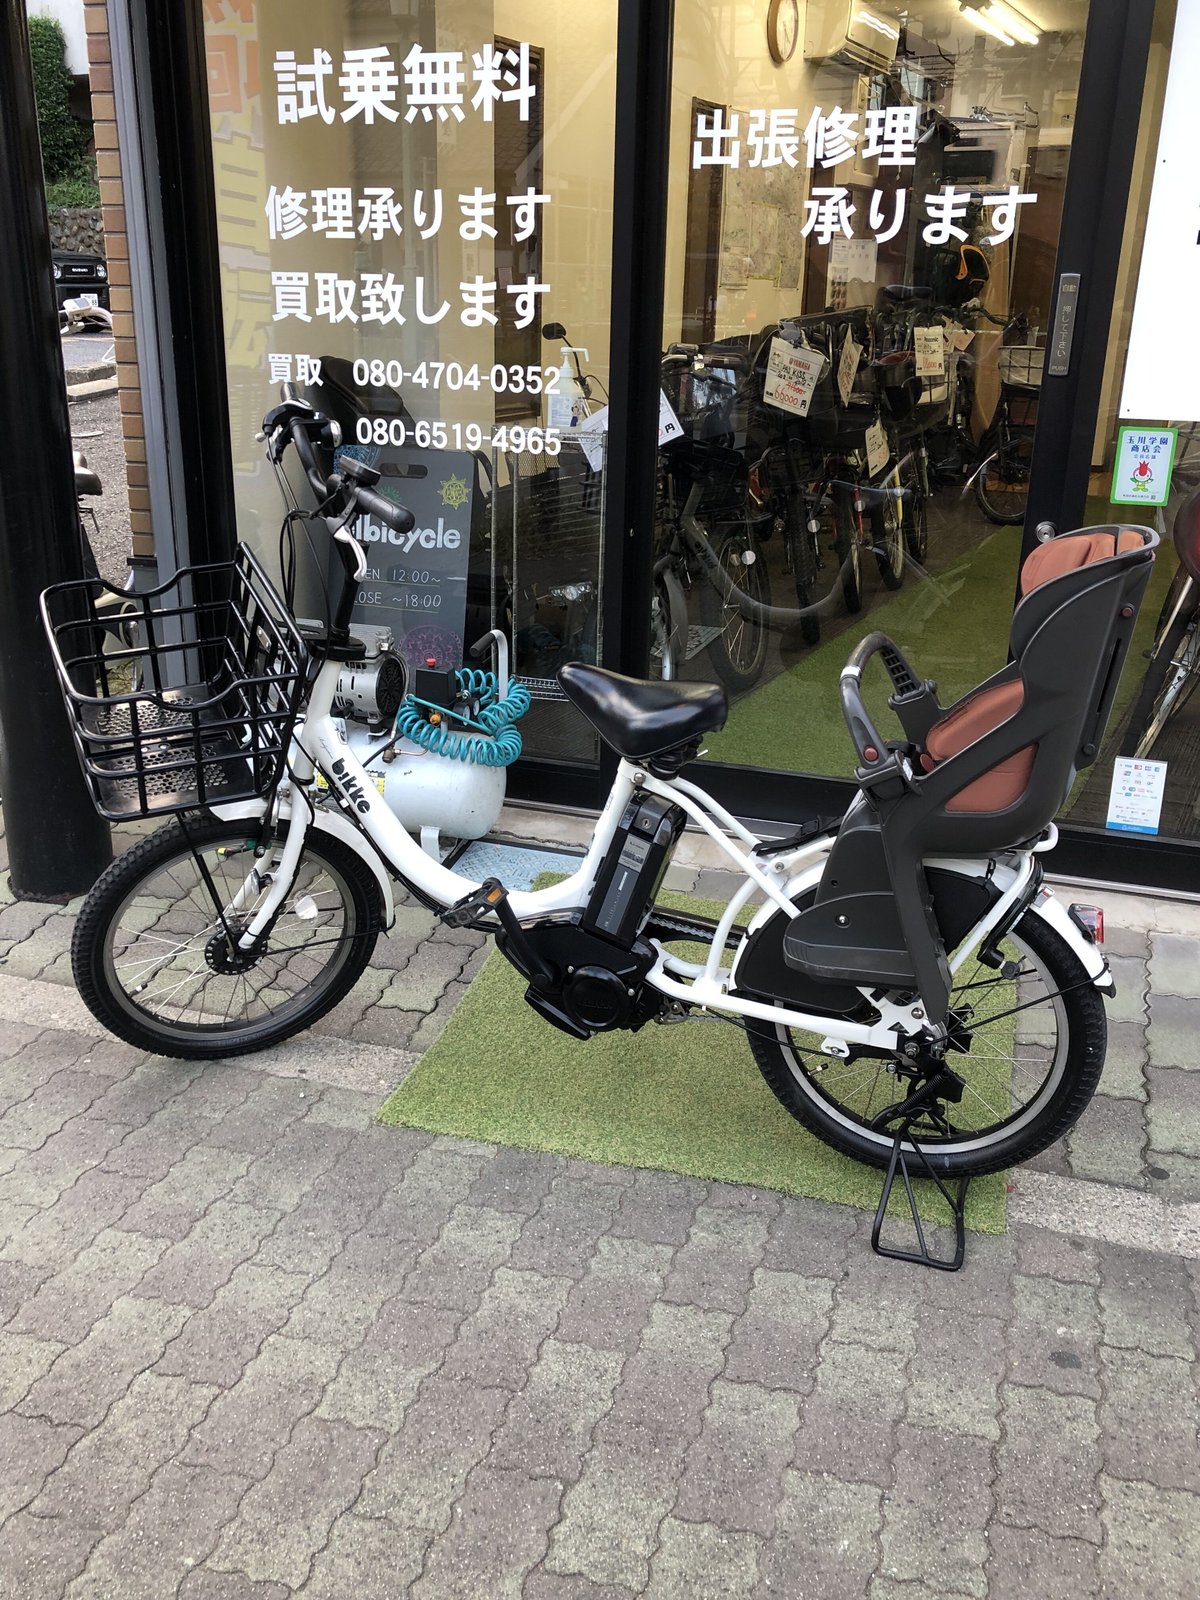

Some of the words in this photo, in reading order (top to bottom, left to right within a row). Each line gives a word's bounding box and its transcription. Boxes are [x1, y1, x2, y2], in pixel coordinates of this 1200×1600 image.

[273, 42, 536, 125] 試乗無料
[692, 105, 918, 169] 出張修理
[264, 184, 552, 242] 修理承ります
[800, 185, 1038, 246] 承ります
[271, 271, 551, 330] 買取致します
[1057, 305, 1072, 358] 押して下さい
[267, 353, 324, 386] 買取
[352, 358, 561, 395] 080-4704-0352
[355, 416, 563, 456] 080-6519-4965
[664, 422, 676, 434] 円
[1127, 435, 1169, 446] 玉川学園
[1131, 444, 1162, 454] 商店会
[352, 514, 461, 554] lbicycle
[331, 757, 371, 814] bikke
